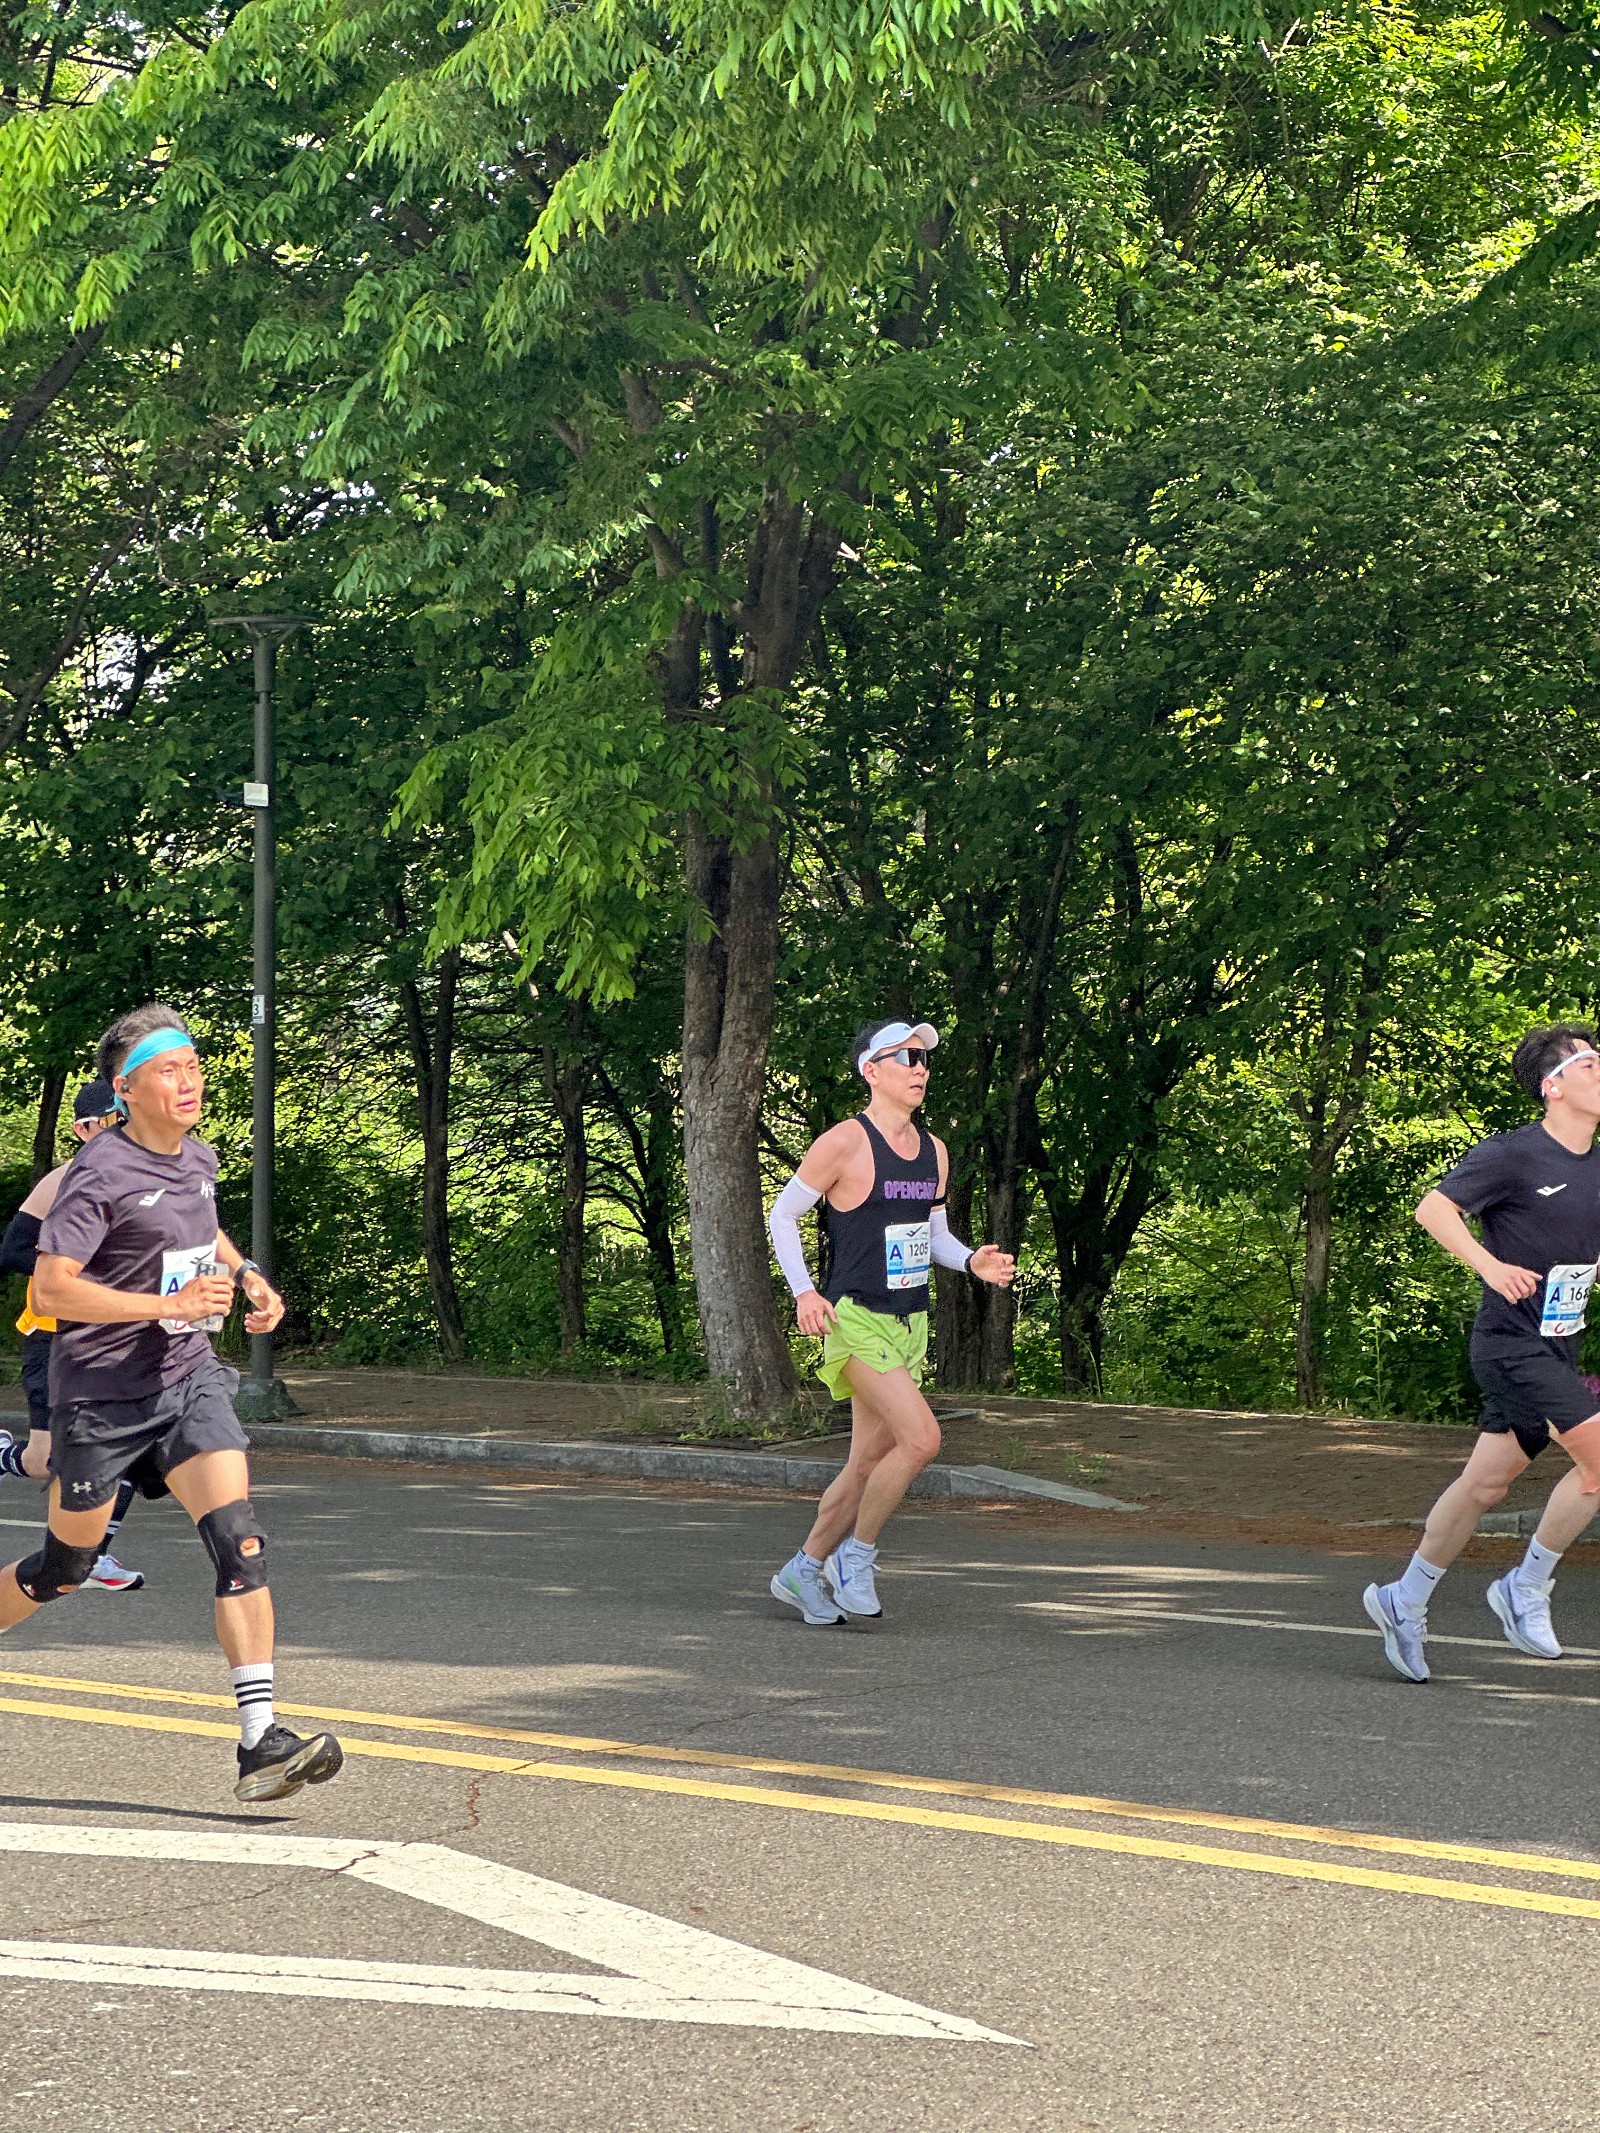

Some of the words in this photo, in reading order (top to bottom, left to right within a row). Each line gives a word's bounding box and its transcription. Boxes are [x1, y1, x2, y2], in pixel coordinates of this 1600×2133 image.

[889, 1243, 903, 1261] A
[909, 1242, 929, 1257] 1205
[1548, 1286, 1561, 1304] A
